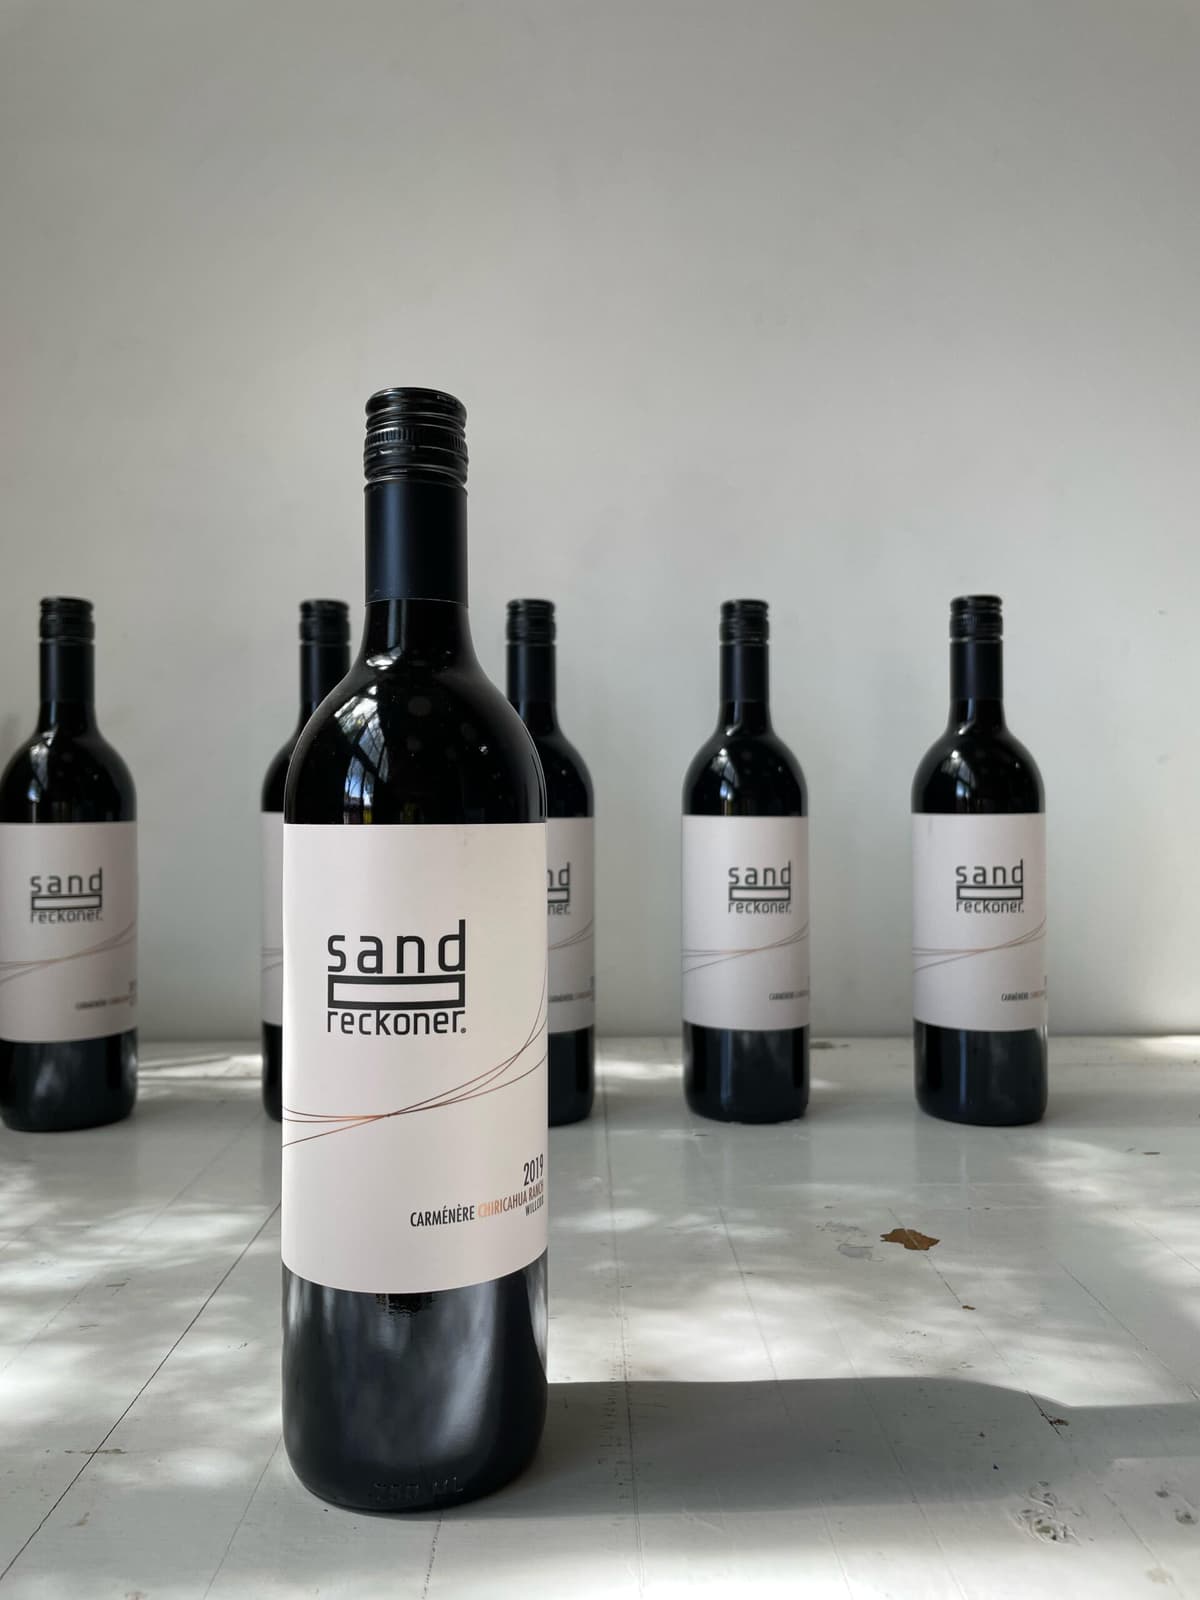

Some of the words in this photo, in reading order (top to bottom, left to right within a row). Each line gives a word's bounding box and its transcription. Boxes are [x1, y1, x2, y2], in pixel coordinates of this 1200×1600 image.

[30, 866, 103, 894] sand
[728, 860, 792, 886] sand
[955, 858, 1024, 885] sand
[327, 919, 466, 974] sand
[523, 1153, 543, 1187] 2019
[410, 1203, 475, 1227] CARMÉNÈRE
[477, 1190, 527, 1218] CHIRICAHUA
